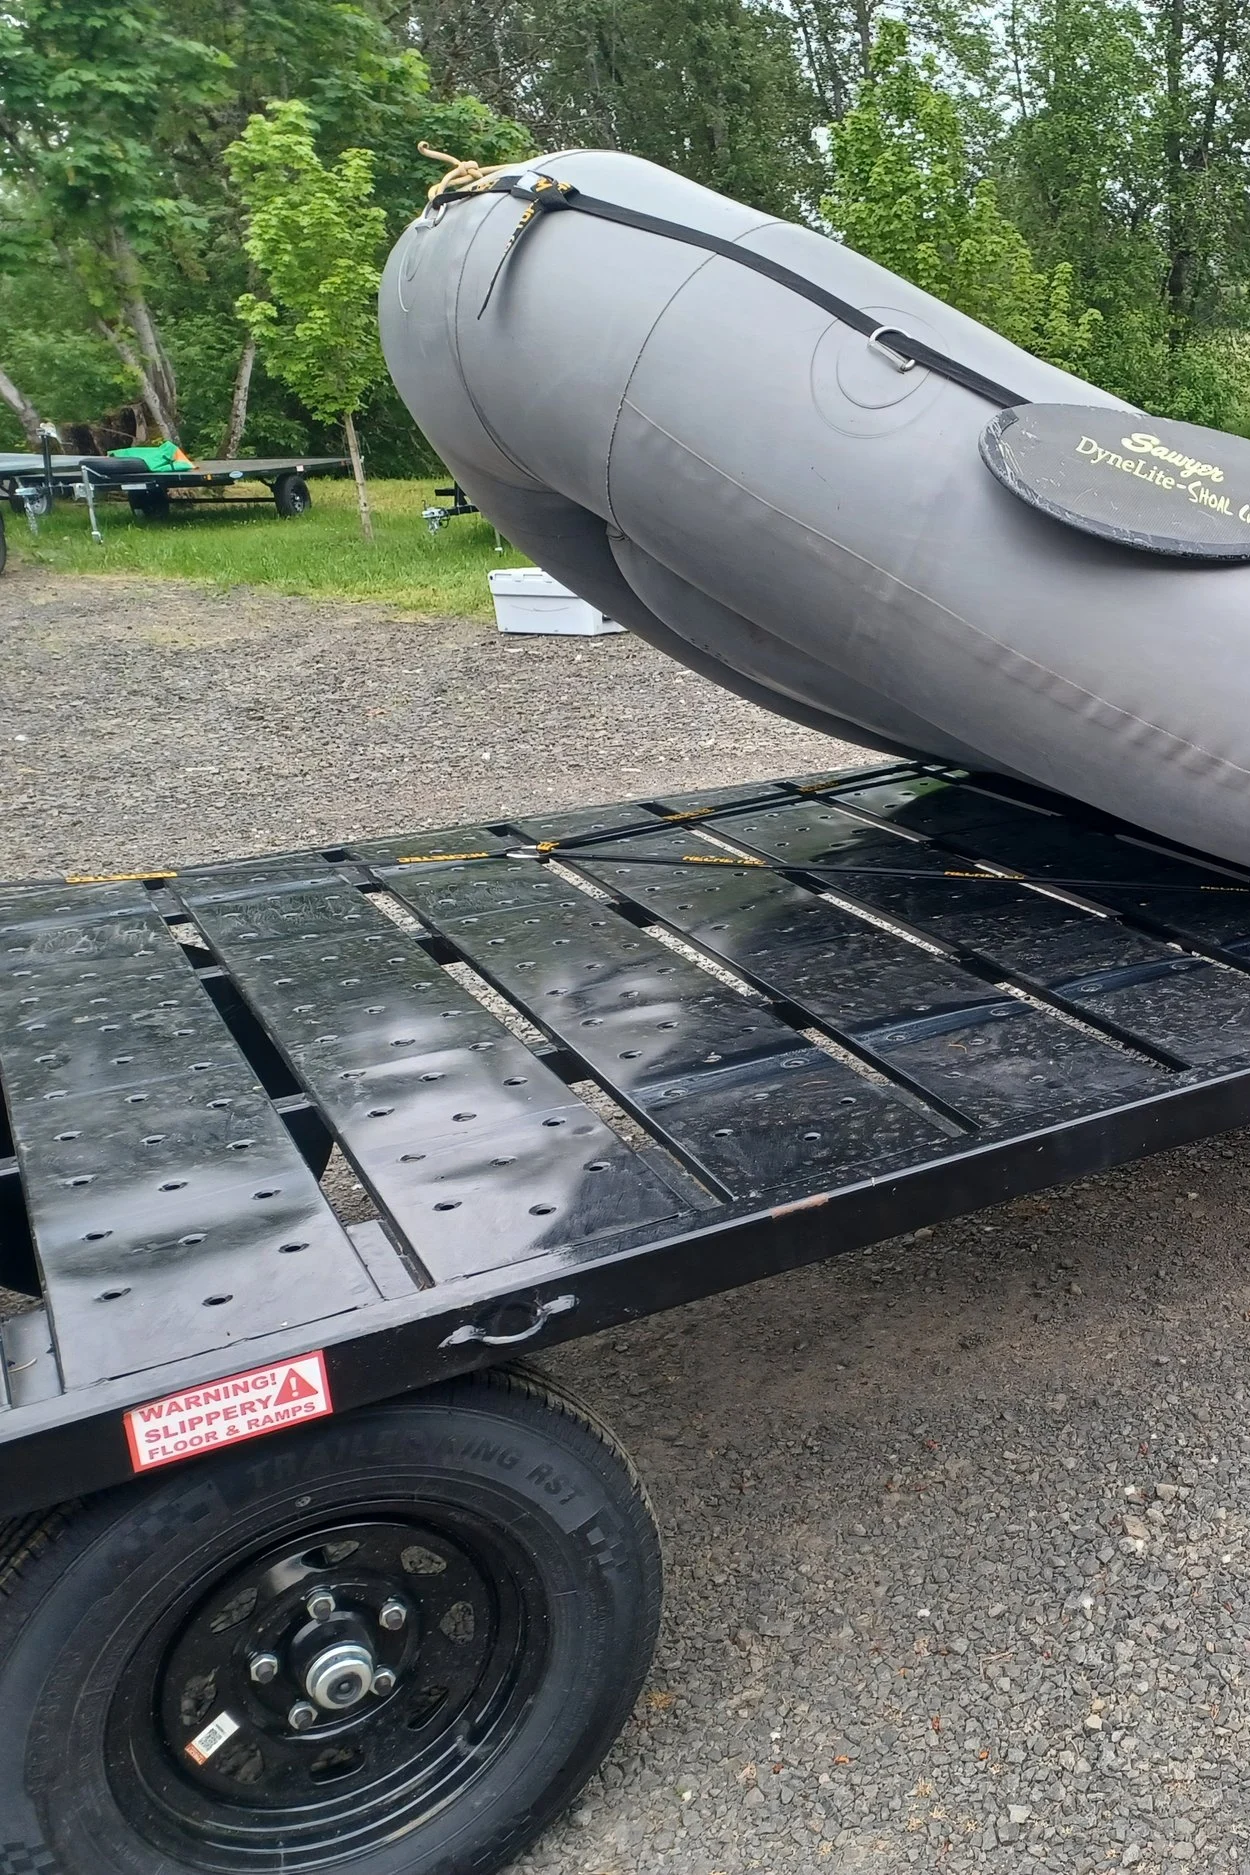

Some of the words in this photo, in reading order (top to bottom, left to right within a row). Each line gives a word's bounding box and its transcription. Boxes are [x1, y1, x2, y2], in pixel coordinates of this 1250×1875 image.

[1121, 432, 1225, 483] Sawyer
[138, 1372, 277, 1423] WARNING!
[144, 1394, 273, 1444] SLIPPERY
[147, 1430, 219, 1460] FLOOR
[225, 1424, 241, 1436] &
[246, 1401, 317, 1430] RAMPS
[524, 1463, 588, 1505] RST
